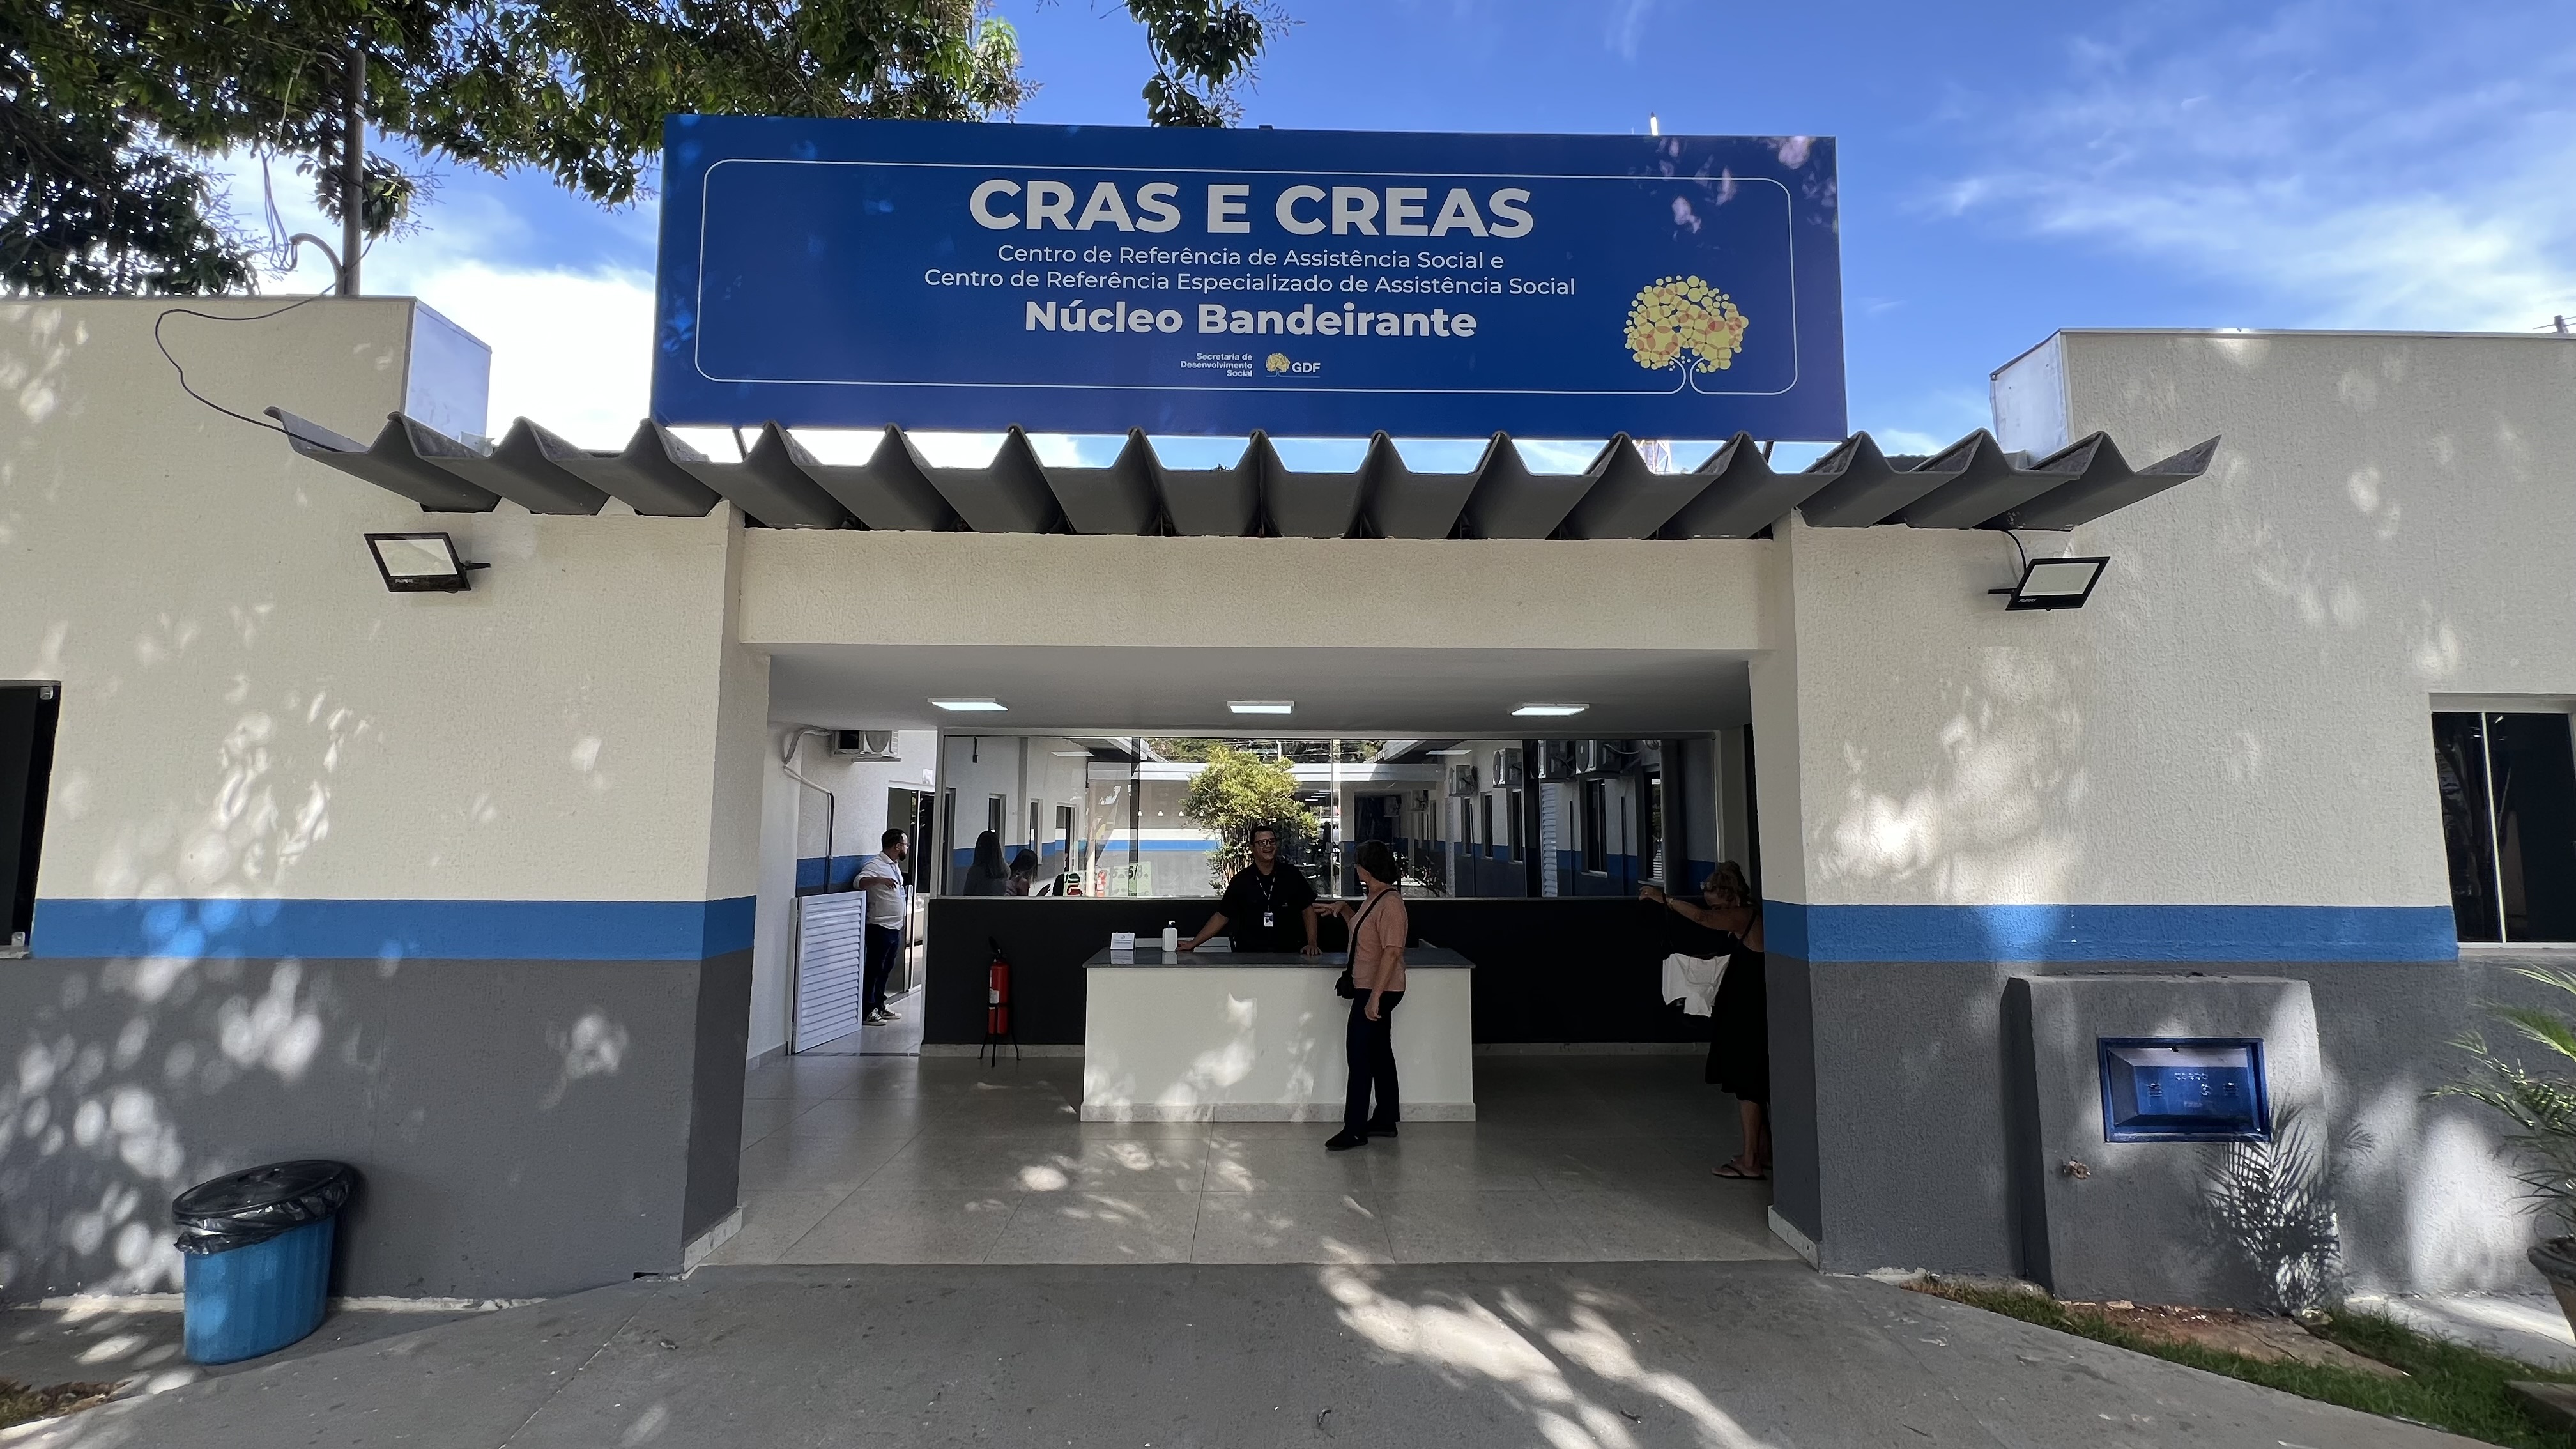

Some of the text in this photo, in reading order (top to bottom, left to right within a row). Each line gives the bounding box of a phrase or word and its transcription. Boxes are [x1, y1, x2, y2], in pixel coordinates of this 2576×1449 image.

[970, 179, 1533, 238] CRAS E CREAS
[998, 245, 1504, 269] Centro de Referência de Assistência Social e
[924, 268, 1575, 295] Centro de Referência Especializado de Assistência Social
[1025, 299, 1477, 337] Núcleo Bandeirante
[1180, 360, 1253, 369] Desenvolvimento
[1196, 352, 1240, 361] Secretaria
[1292, 362, 1321, 373] GDF
